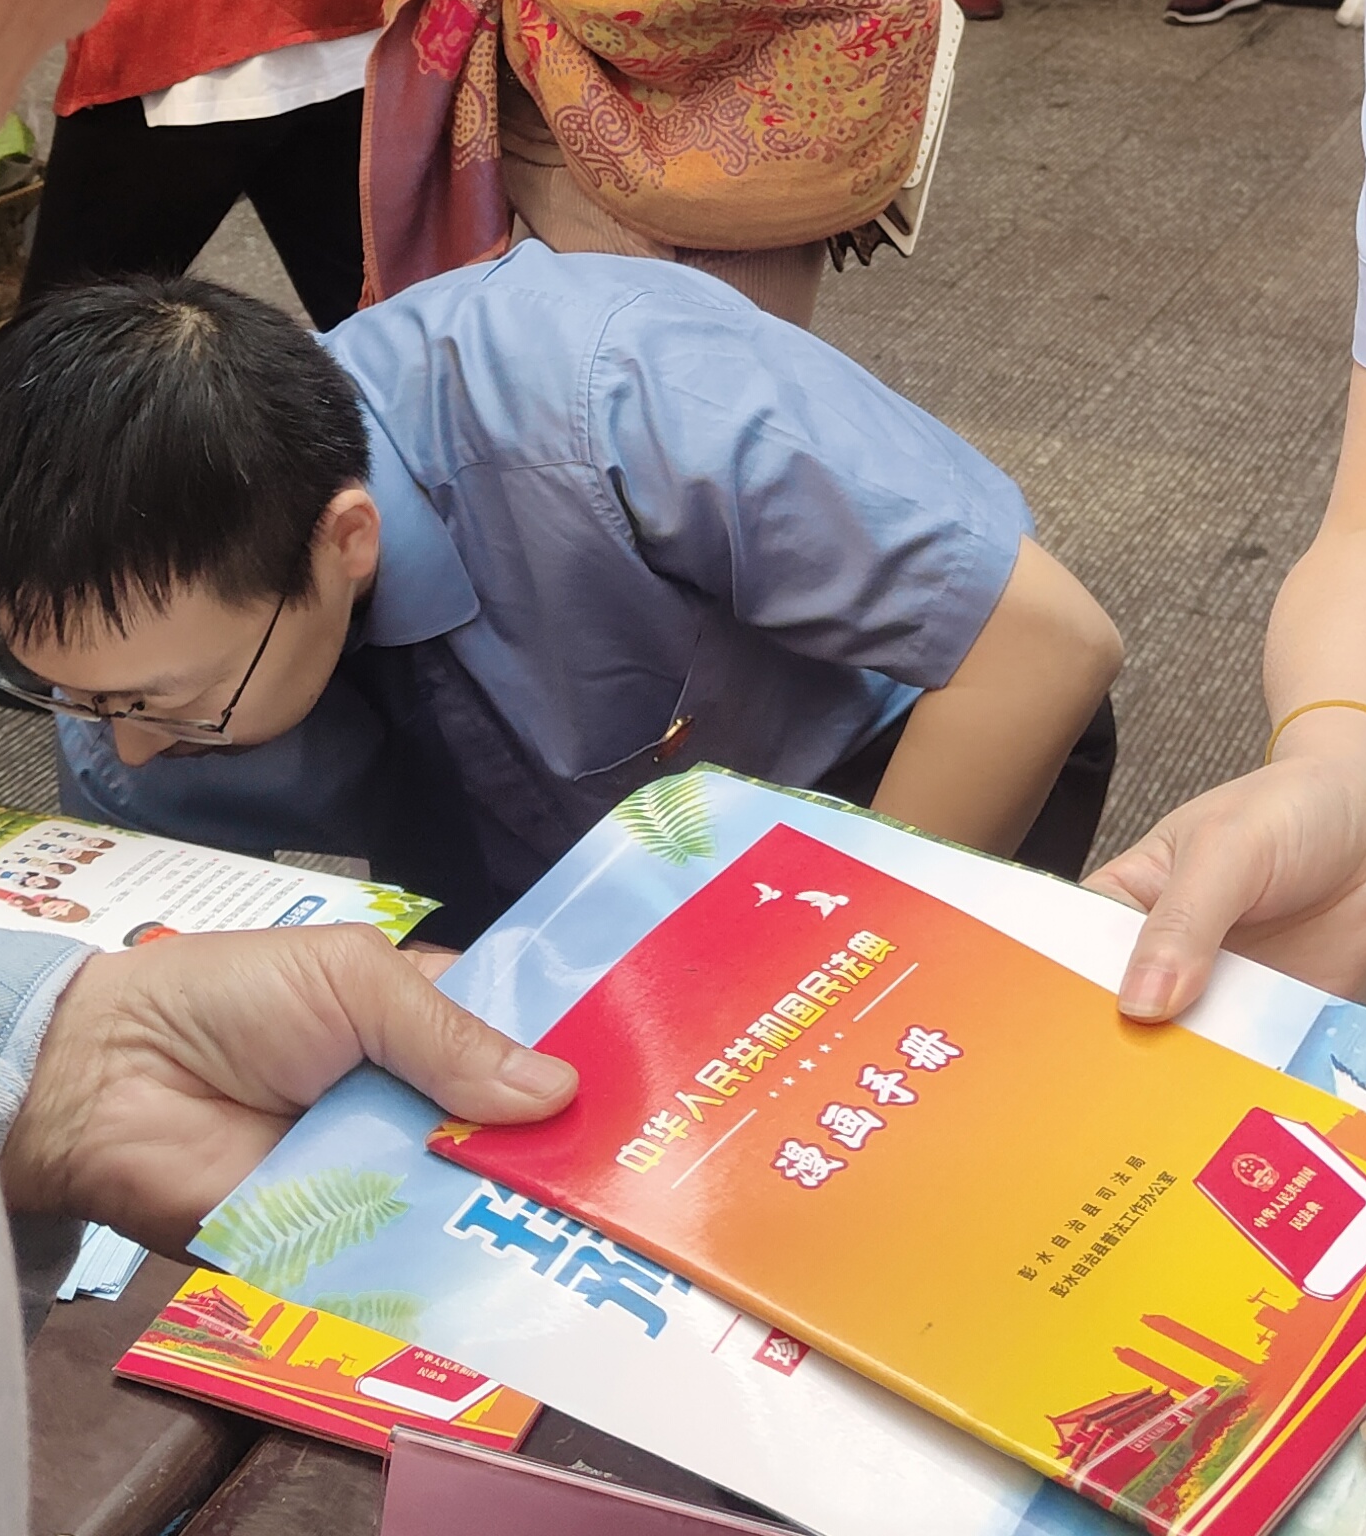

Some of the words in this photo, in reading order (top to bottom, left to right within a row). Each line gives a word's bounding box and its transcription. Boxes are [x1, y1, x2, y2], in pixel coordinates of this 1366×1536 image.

[615, 929, 897, 1174] 中华人民共和国民法典
[772, 1026, 963, 1189] 漫画手册
[1017, 1154, 1146, 1282] 彭水自治县司法局
[1253, 1165, 1318, 1228] 中华人民共和国
[1289, 1199, 1324, 1231] 民法典
[1049, 1170, 1178, 1299] 彭水自治县普法工作办公室
[414, 1351, 479, 1379] 中华人民共和国
[416, 1366, 448, 1383] 民法典
[764, 1337, 799, 1366] 珍
